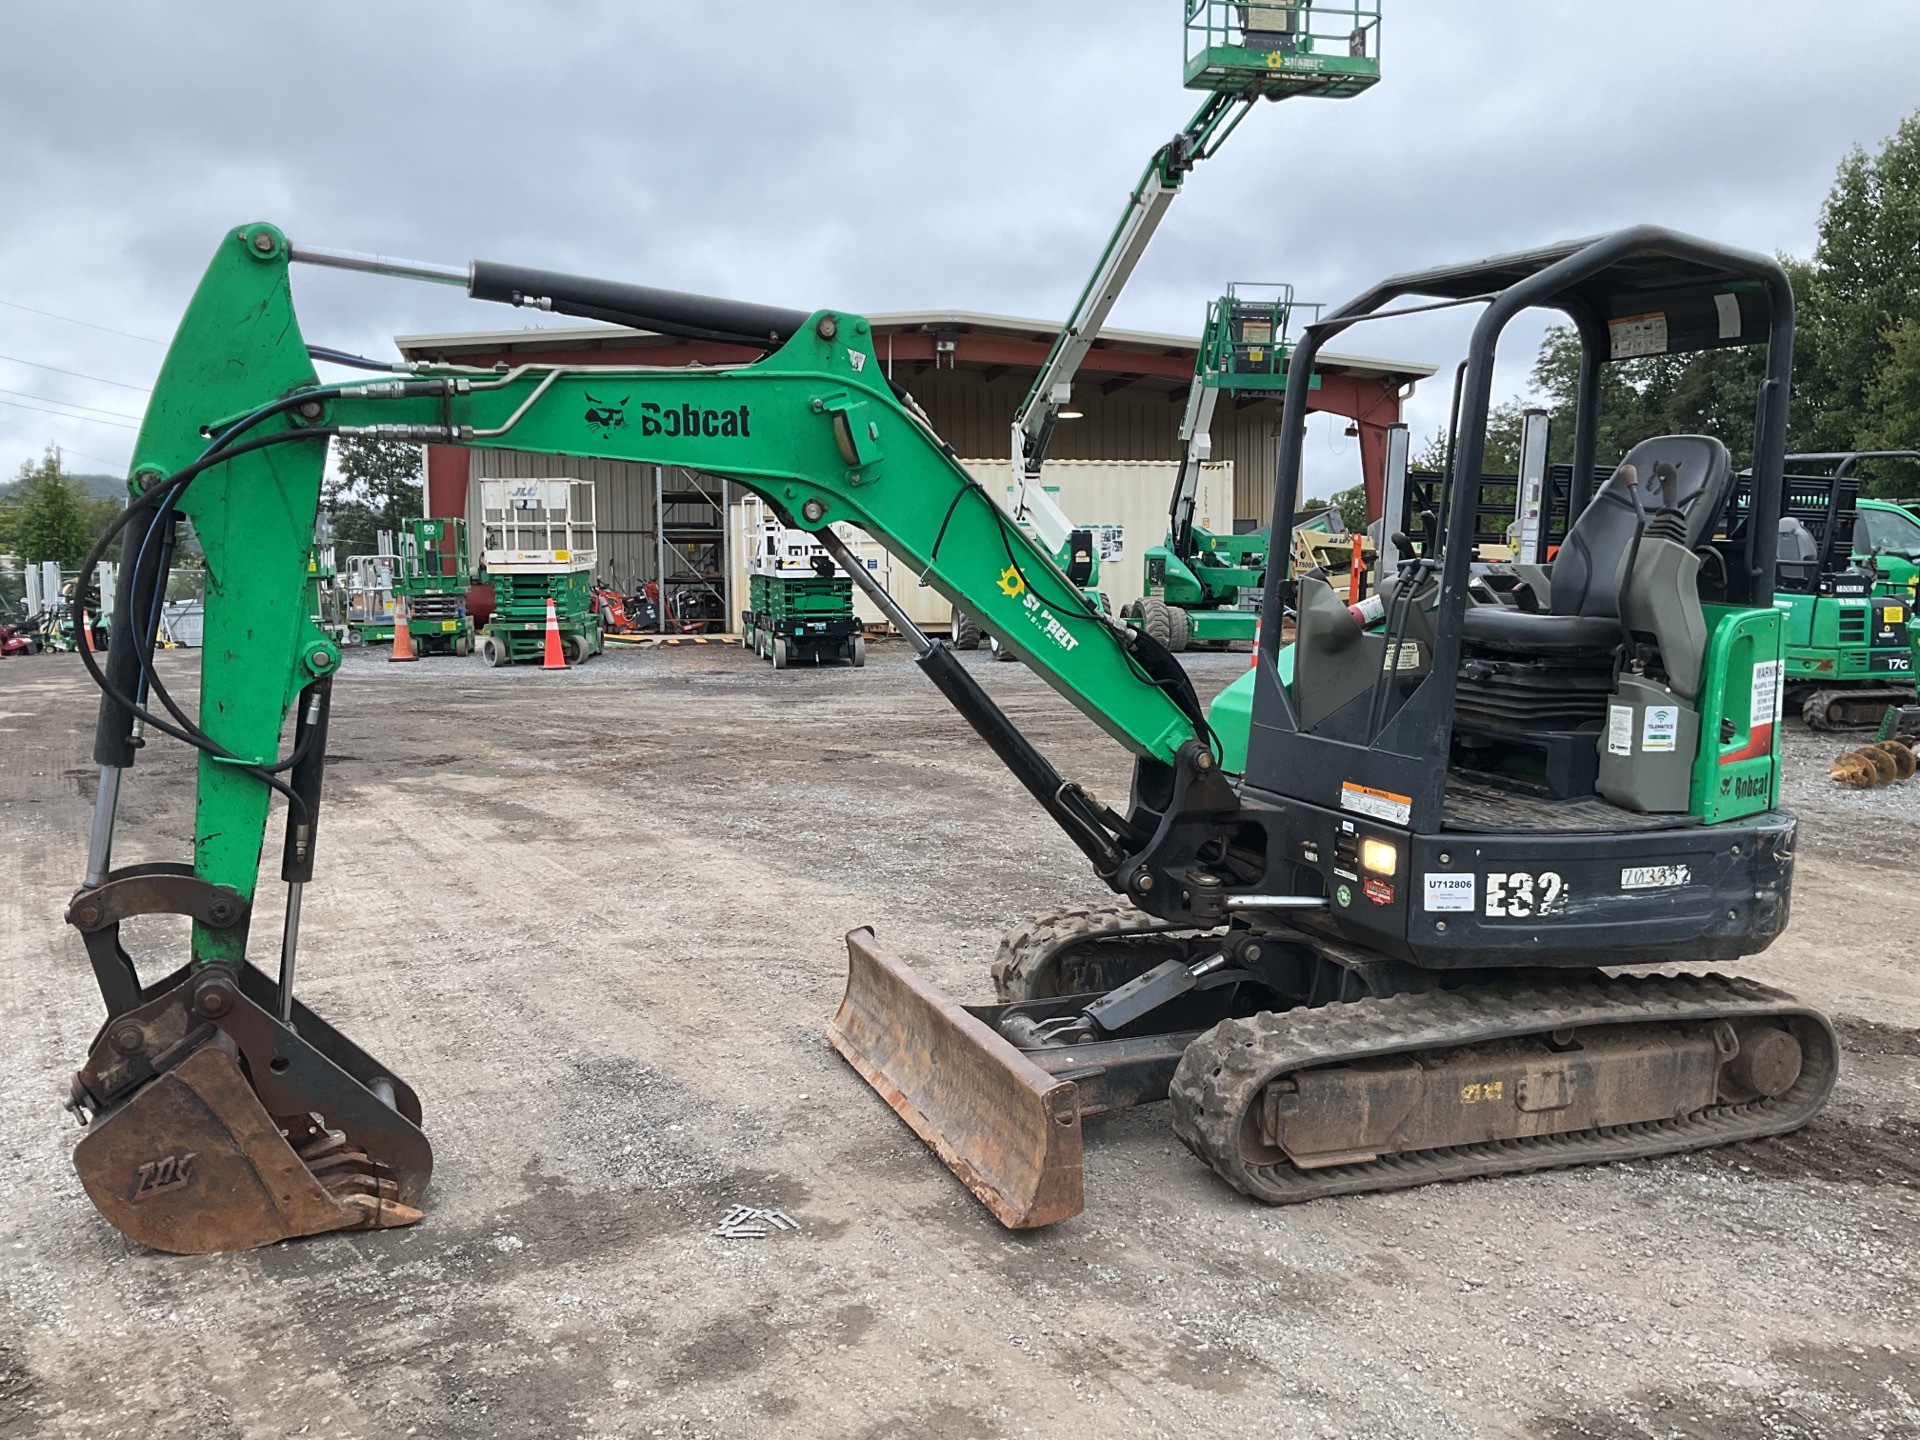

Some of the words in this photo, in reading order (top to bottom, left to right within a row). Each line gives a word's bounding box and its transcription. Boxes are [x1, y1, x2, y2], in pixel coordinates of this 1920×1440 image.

[641, 402, 750, 437] Bobcat
[1888, 658, 1909, 669] 17G
[1429, 880, 1472, 889] U712806
